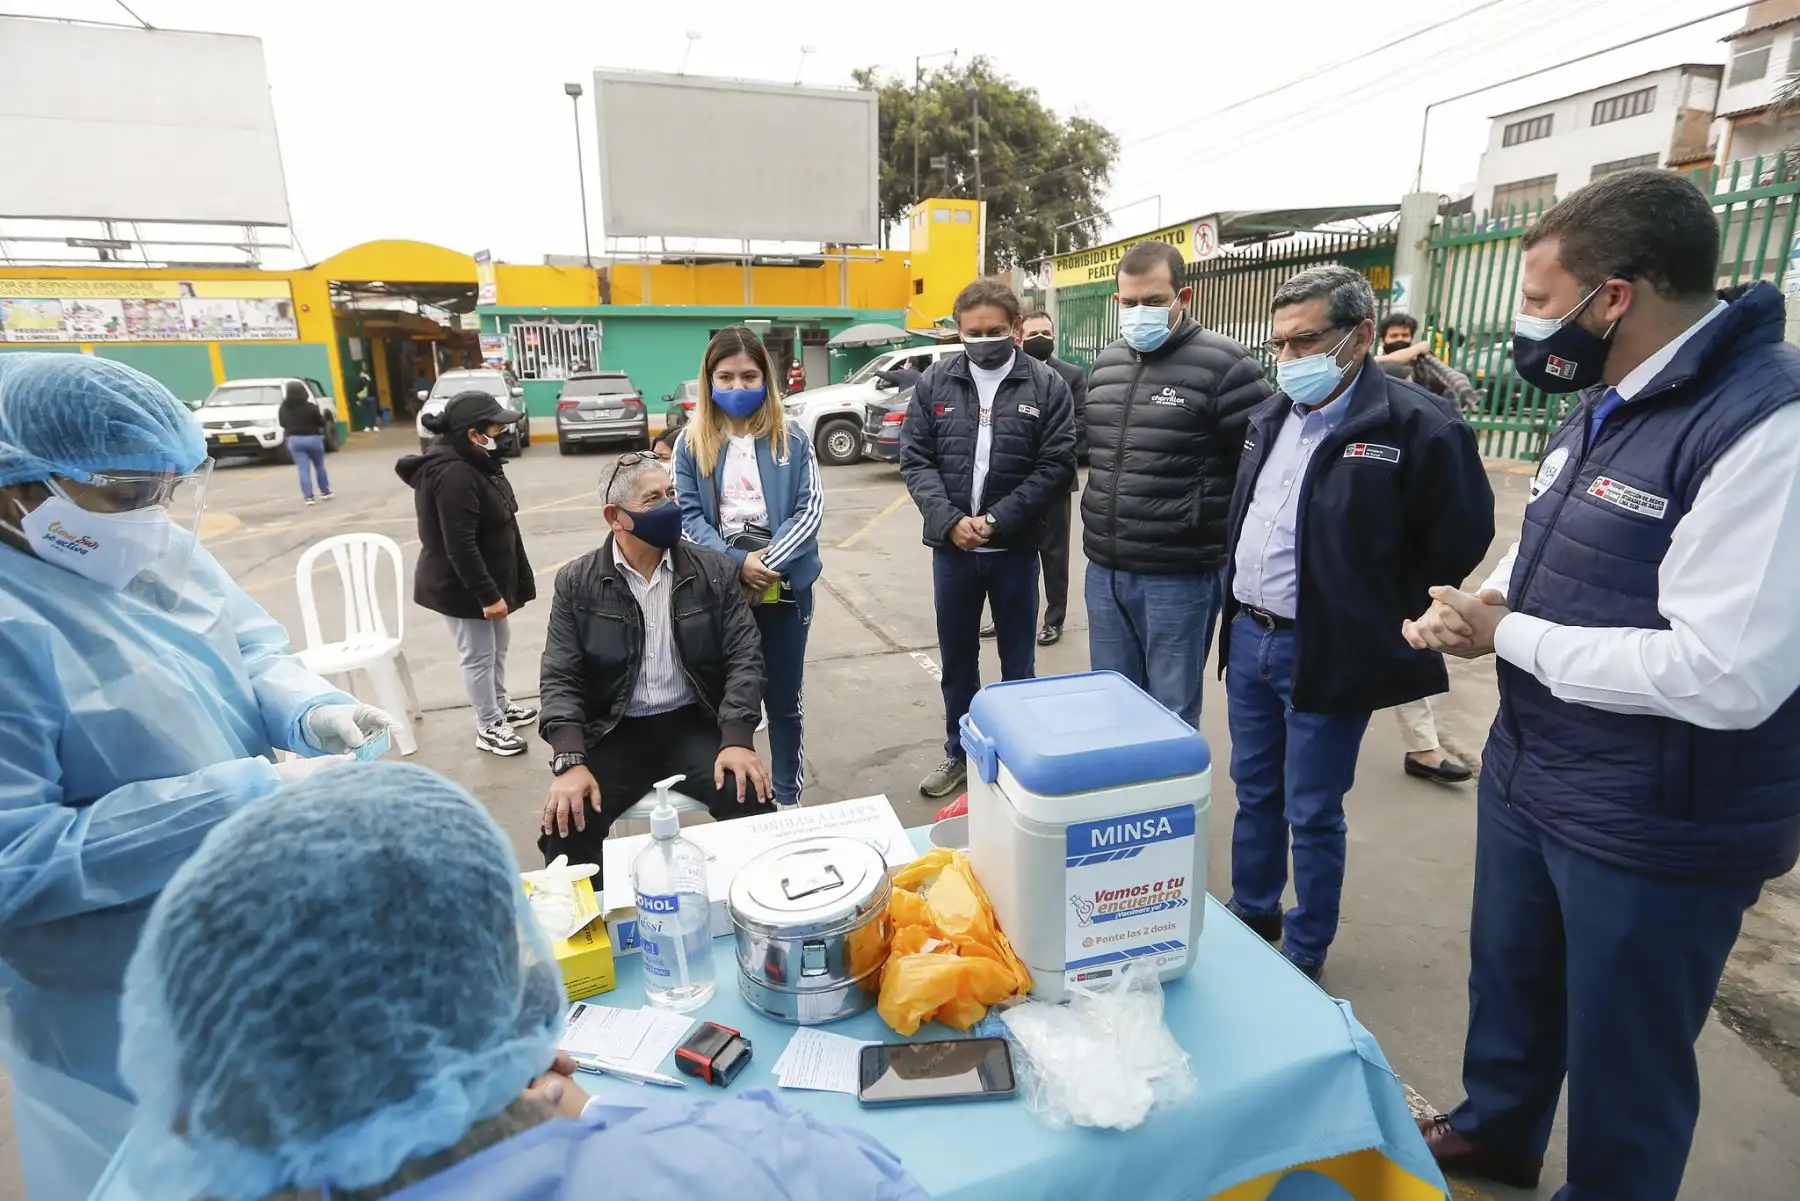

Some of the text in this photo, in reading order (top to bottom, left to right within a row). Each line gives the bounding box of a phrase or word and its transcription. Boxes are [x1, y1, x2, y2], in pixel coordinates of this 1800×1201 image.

[1056, 250, 1107, 271] PROHIBIDO
[1109, 247, 1121, 260] EL
[1151, 395, 1185, 404] chorrillos
[1162, 387, 1176, 397] Ch
[55, 540, 89, 556] activa
[1091, 816, 1173, 848] MINSA
[1095, 876, 1185, 903] Vamos a tu
[1097, 888, 1182, 914] encuentro
[637, 895, 675, 911] OHOL
[1096, 921, 1177, 945] Ponte las 2 dosis
